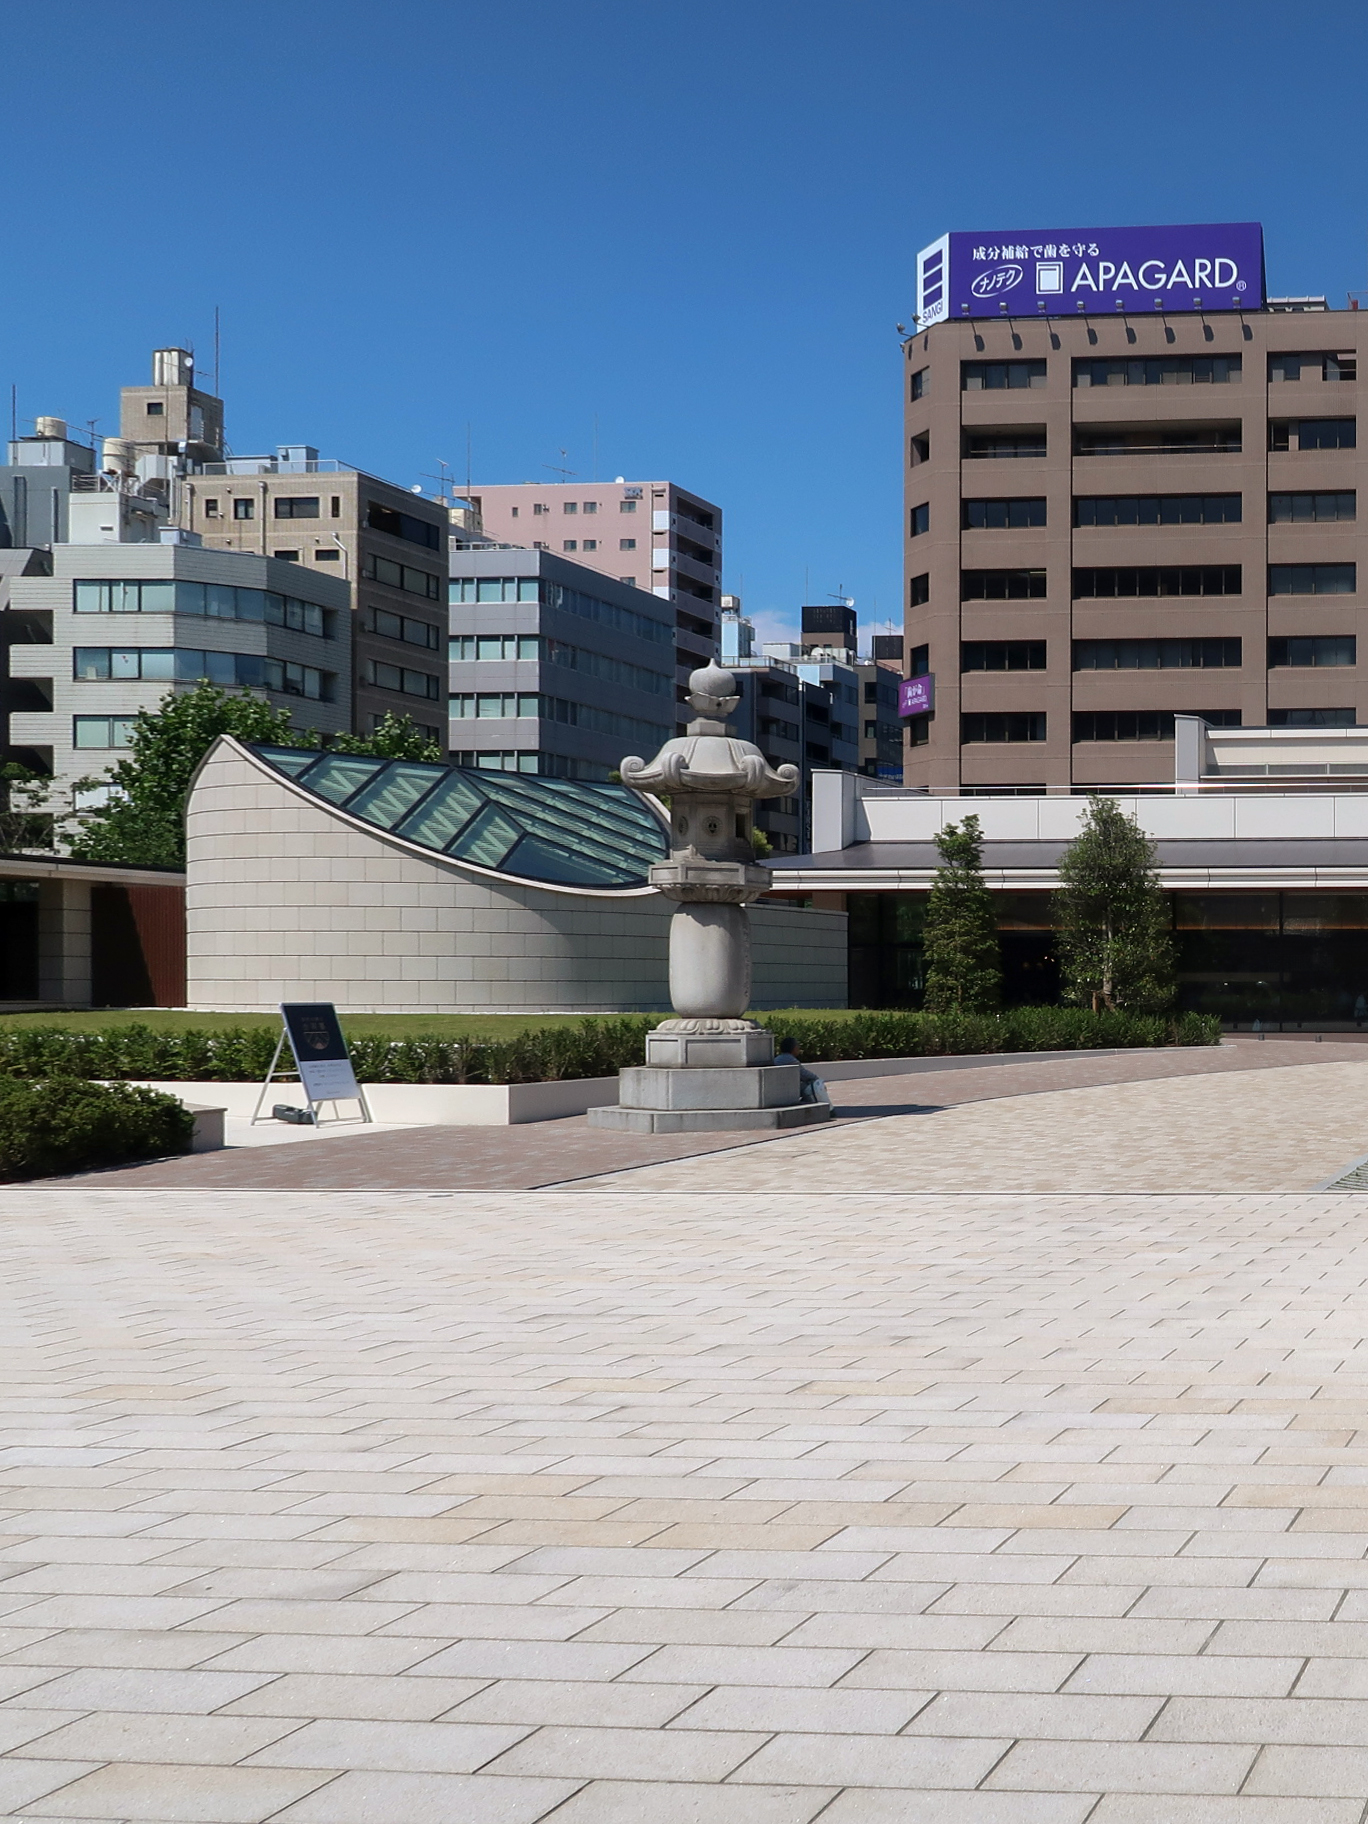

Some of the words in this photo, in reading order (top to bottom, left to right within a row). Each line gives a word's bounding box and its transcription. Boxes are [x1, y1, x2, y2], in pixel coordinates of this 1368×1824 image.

[972, 242, 1100, 261] 成分補給で歯を守る
[978, 269, 1016, 293] ナノテク
[922, 300, 943, 324] SANGI
